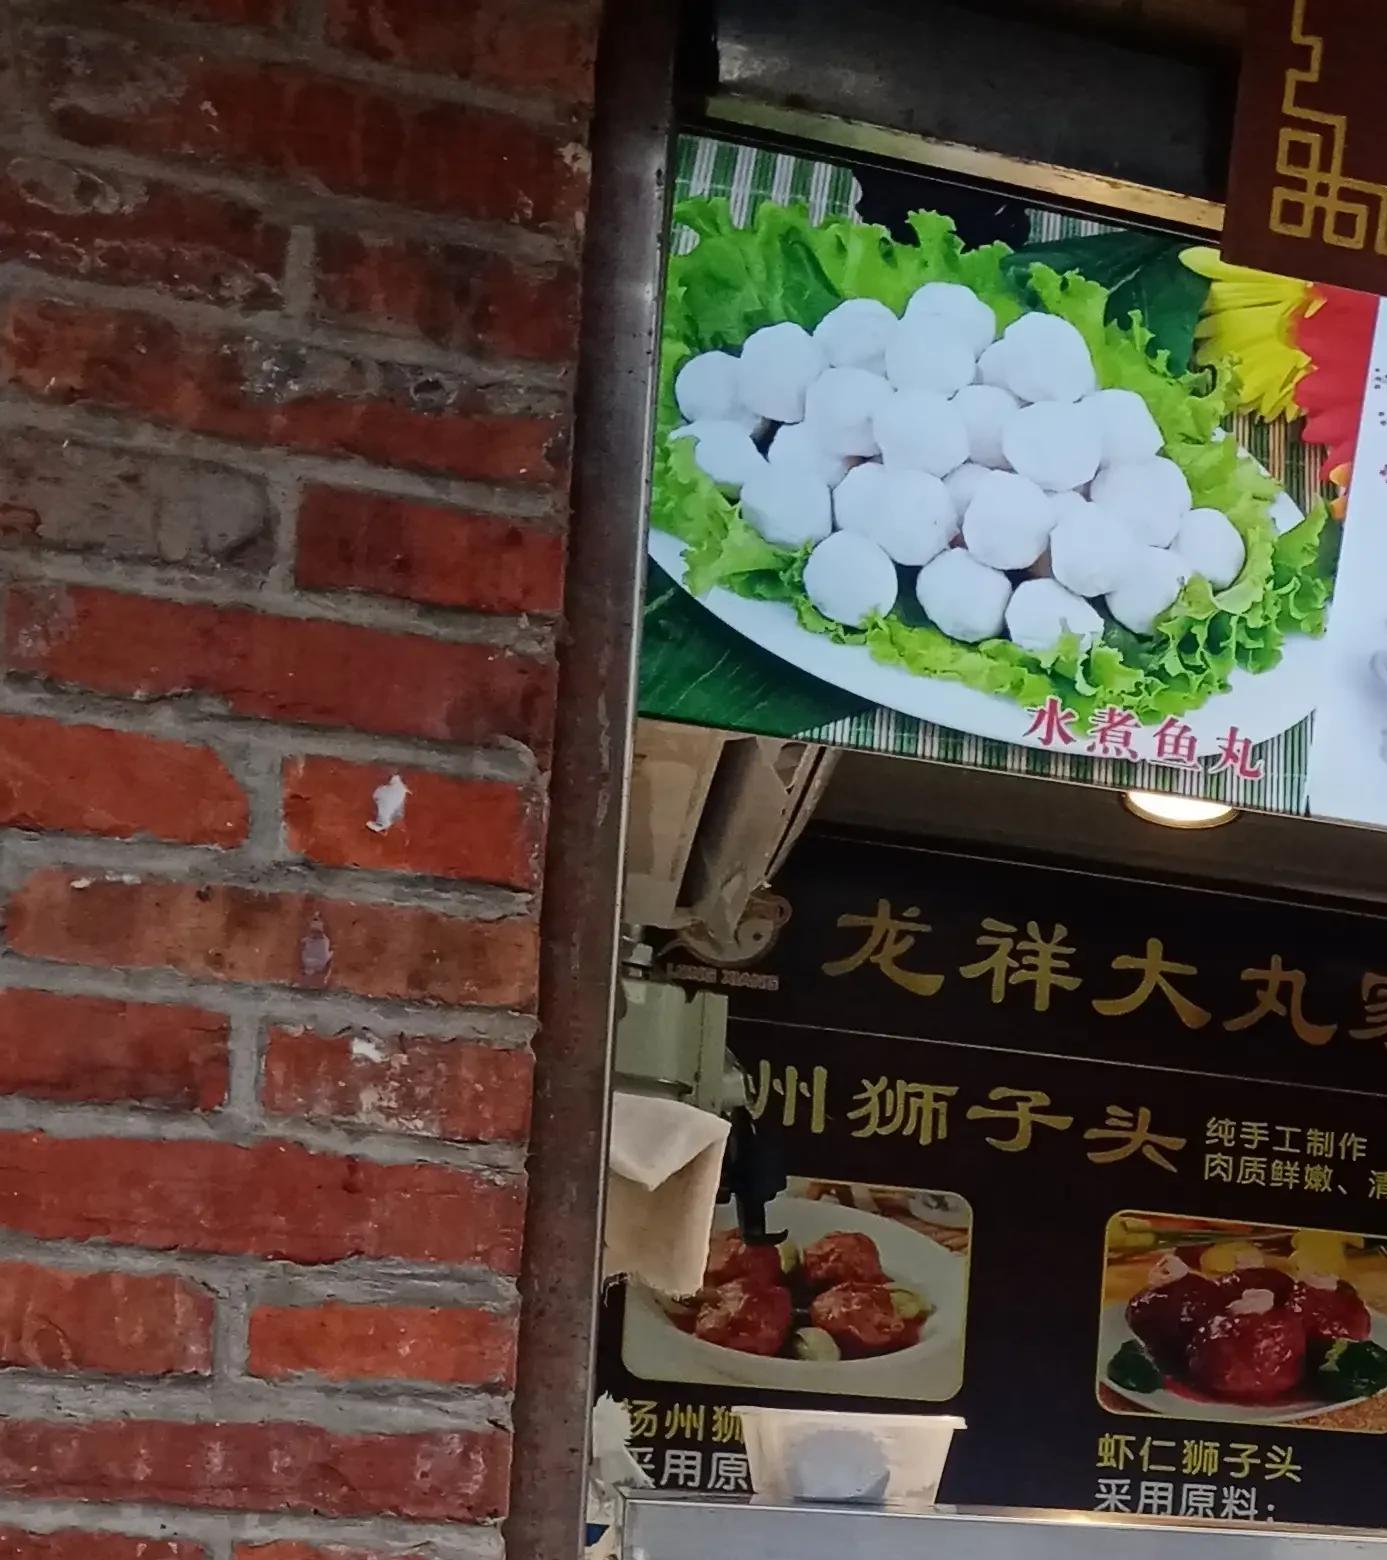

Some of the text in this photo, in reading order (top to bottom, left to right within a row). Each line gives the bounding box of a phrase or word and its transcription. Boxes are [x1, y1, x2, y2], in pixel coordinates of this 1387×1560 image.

[1022, 696, 1265, 781] 水煮鱼丸
[1205, 1115, 1369, 1162] 纯手工制作
[1095, 1432, 1303, 1483] 虾仁狮子头
